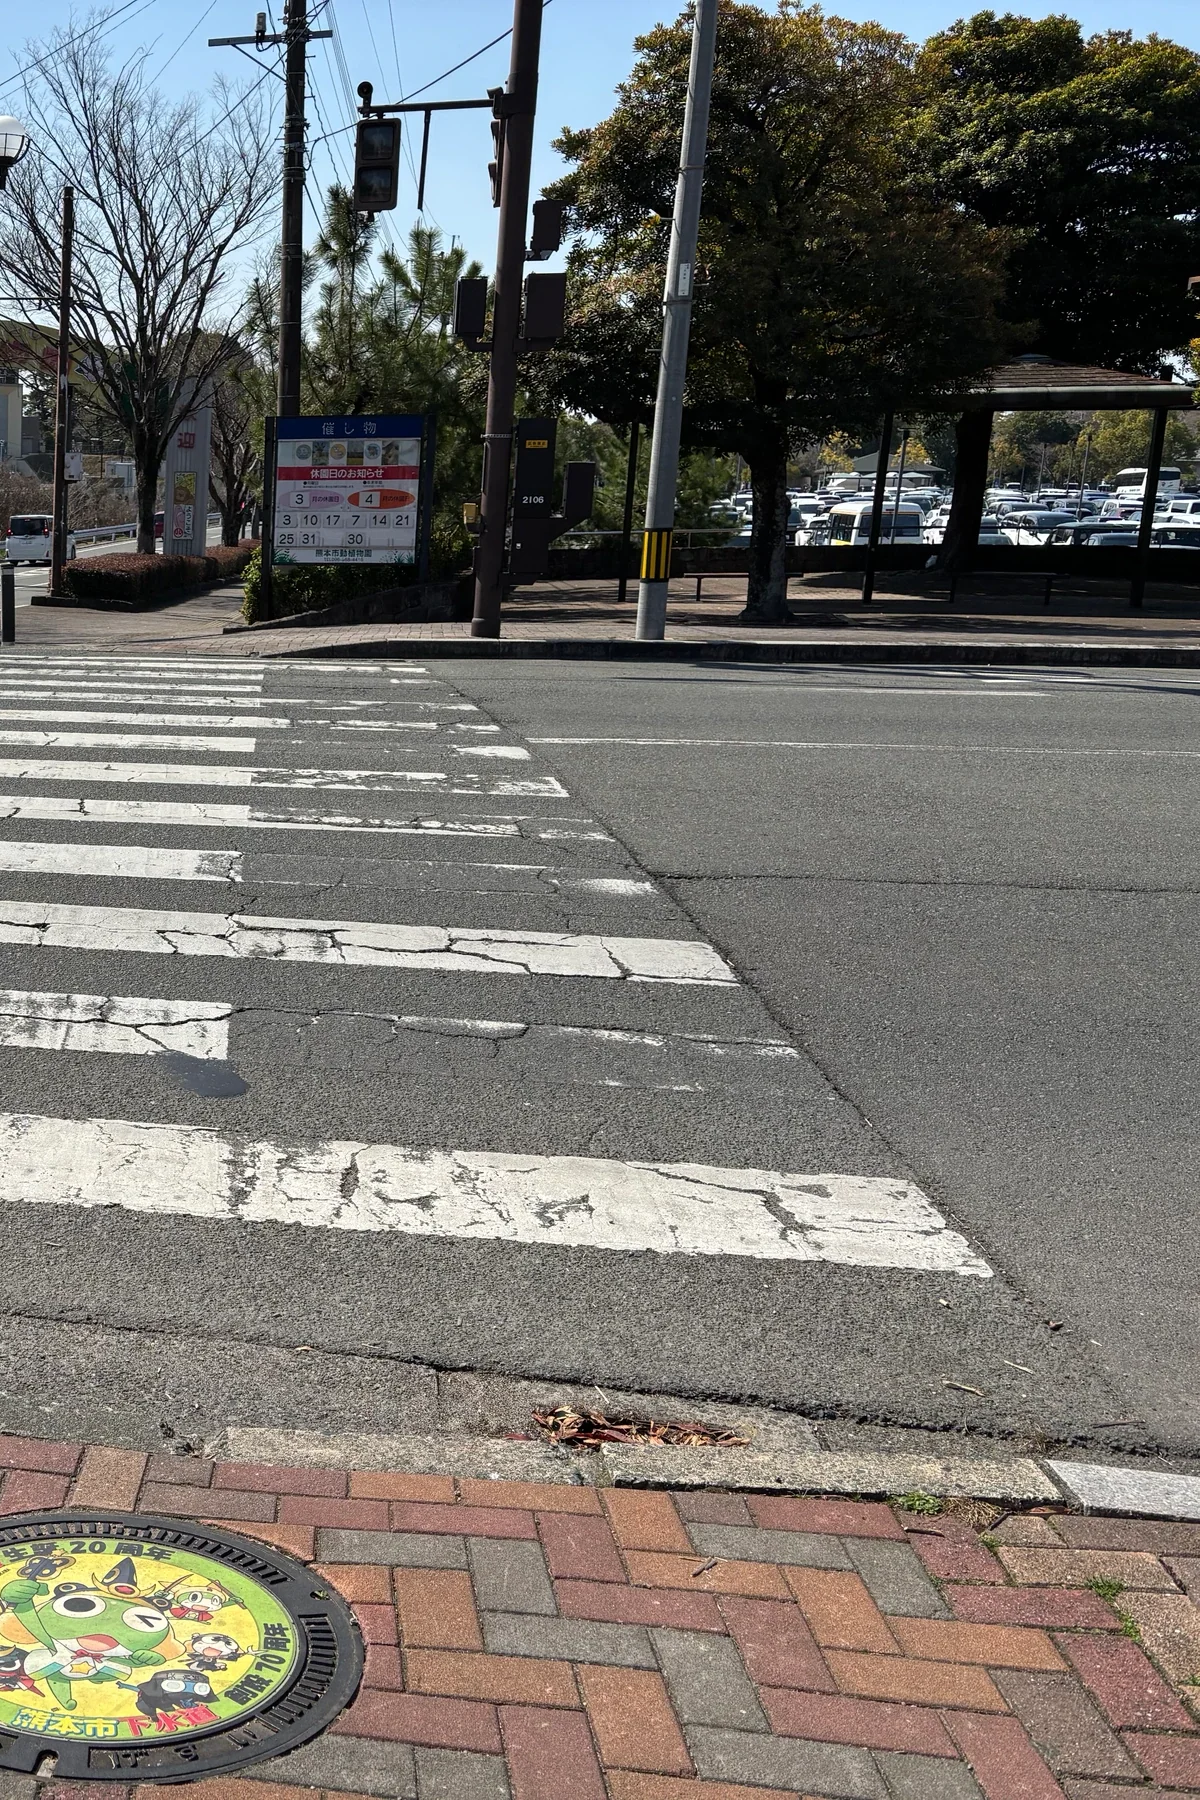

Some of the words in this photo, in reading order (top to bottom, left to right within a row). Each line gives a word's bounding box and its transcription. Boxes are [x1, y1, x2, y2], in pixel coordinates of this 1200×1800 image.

[322, 422, 377, 435] 催し物
[310, 468, 384, 479] 休園日のお知らせ
[295, 493, 304, 505] 3
[365, 493, 373, 505] 4
[522, 496, 545, 504] 2106
[282, 514, 292, 526] 3
[303, 514, 318, 526] 10
[326, 514, 341, 526] 17
[352, 515, 360, 526] 7
[372, 514, 387, 526] 14
[395, 514, 409, 526] 21
[279, 533, 294, 545] 25
[302, 533, 316, 545] 31
[347, 533, 363, 545] 30
[315, 549, 372, 557] 熊本市動植物園
[2, 1540, 177, 1563] 生誕20周年
[223, 1622, 292, 1706] 創設70周年
[10, 1707, 120, 1739] 熊本市
[124, 1703, 222, 1738] 下水道
